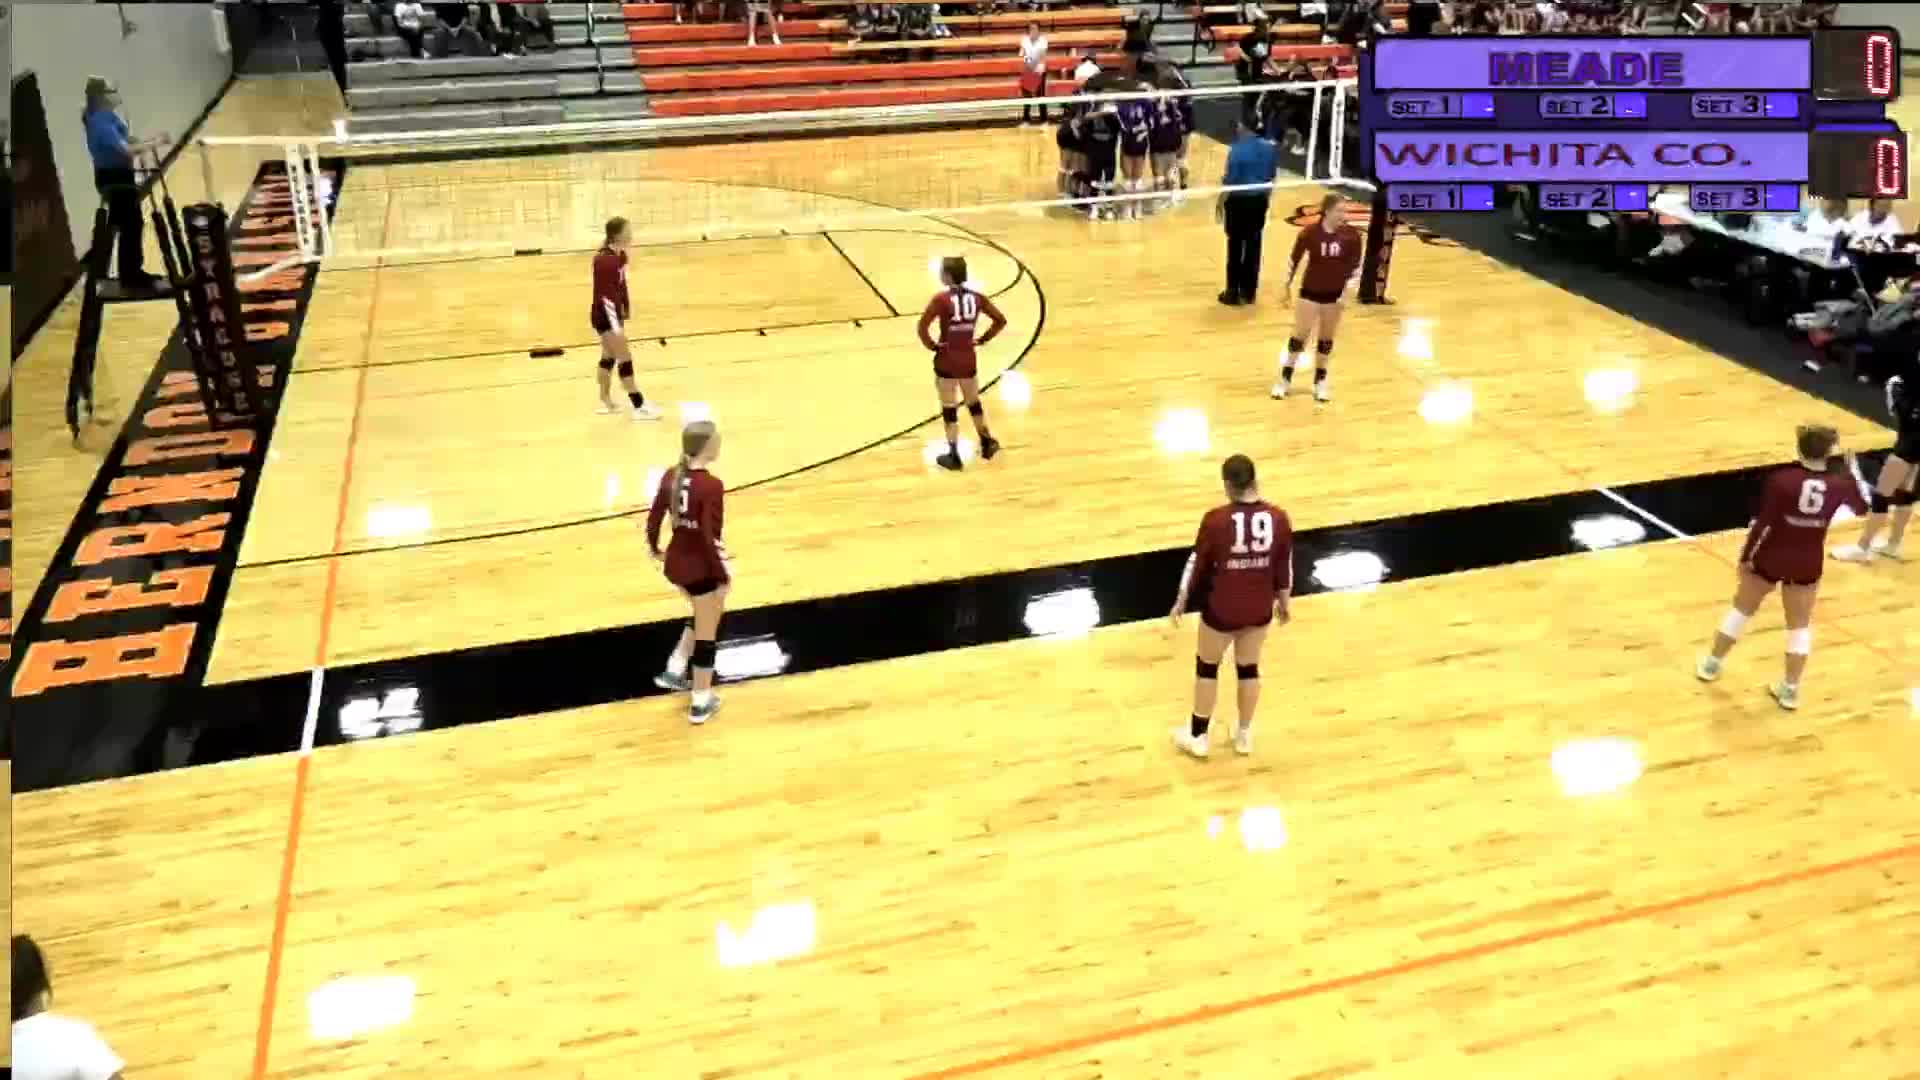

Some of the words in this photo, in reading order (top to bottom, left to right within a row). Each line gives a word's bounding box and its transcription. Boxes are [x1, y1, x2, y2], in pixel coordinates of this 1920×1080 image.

[950, 293, 978, 322] 10
[1798, 478, 1827, 515] 6
[1229, 510, 1274, 554] 19
